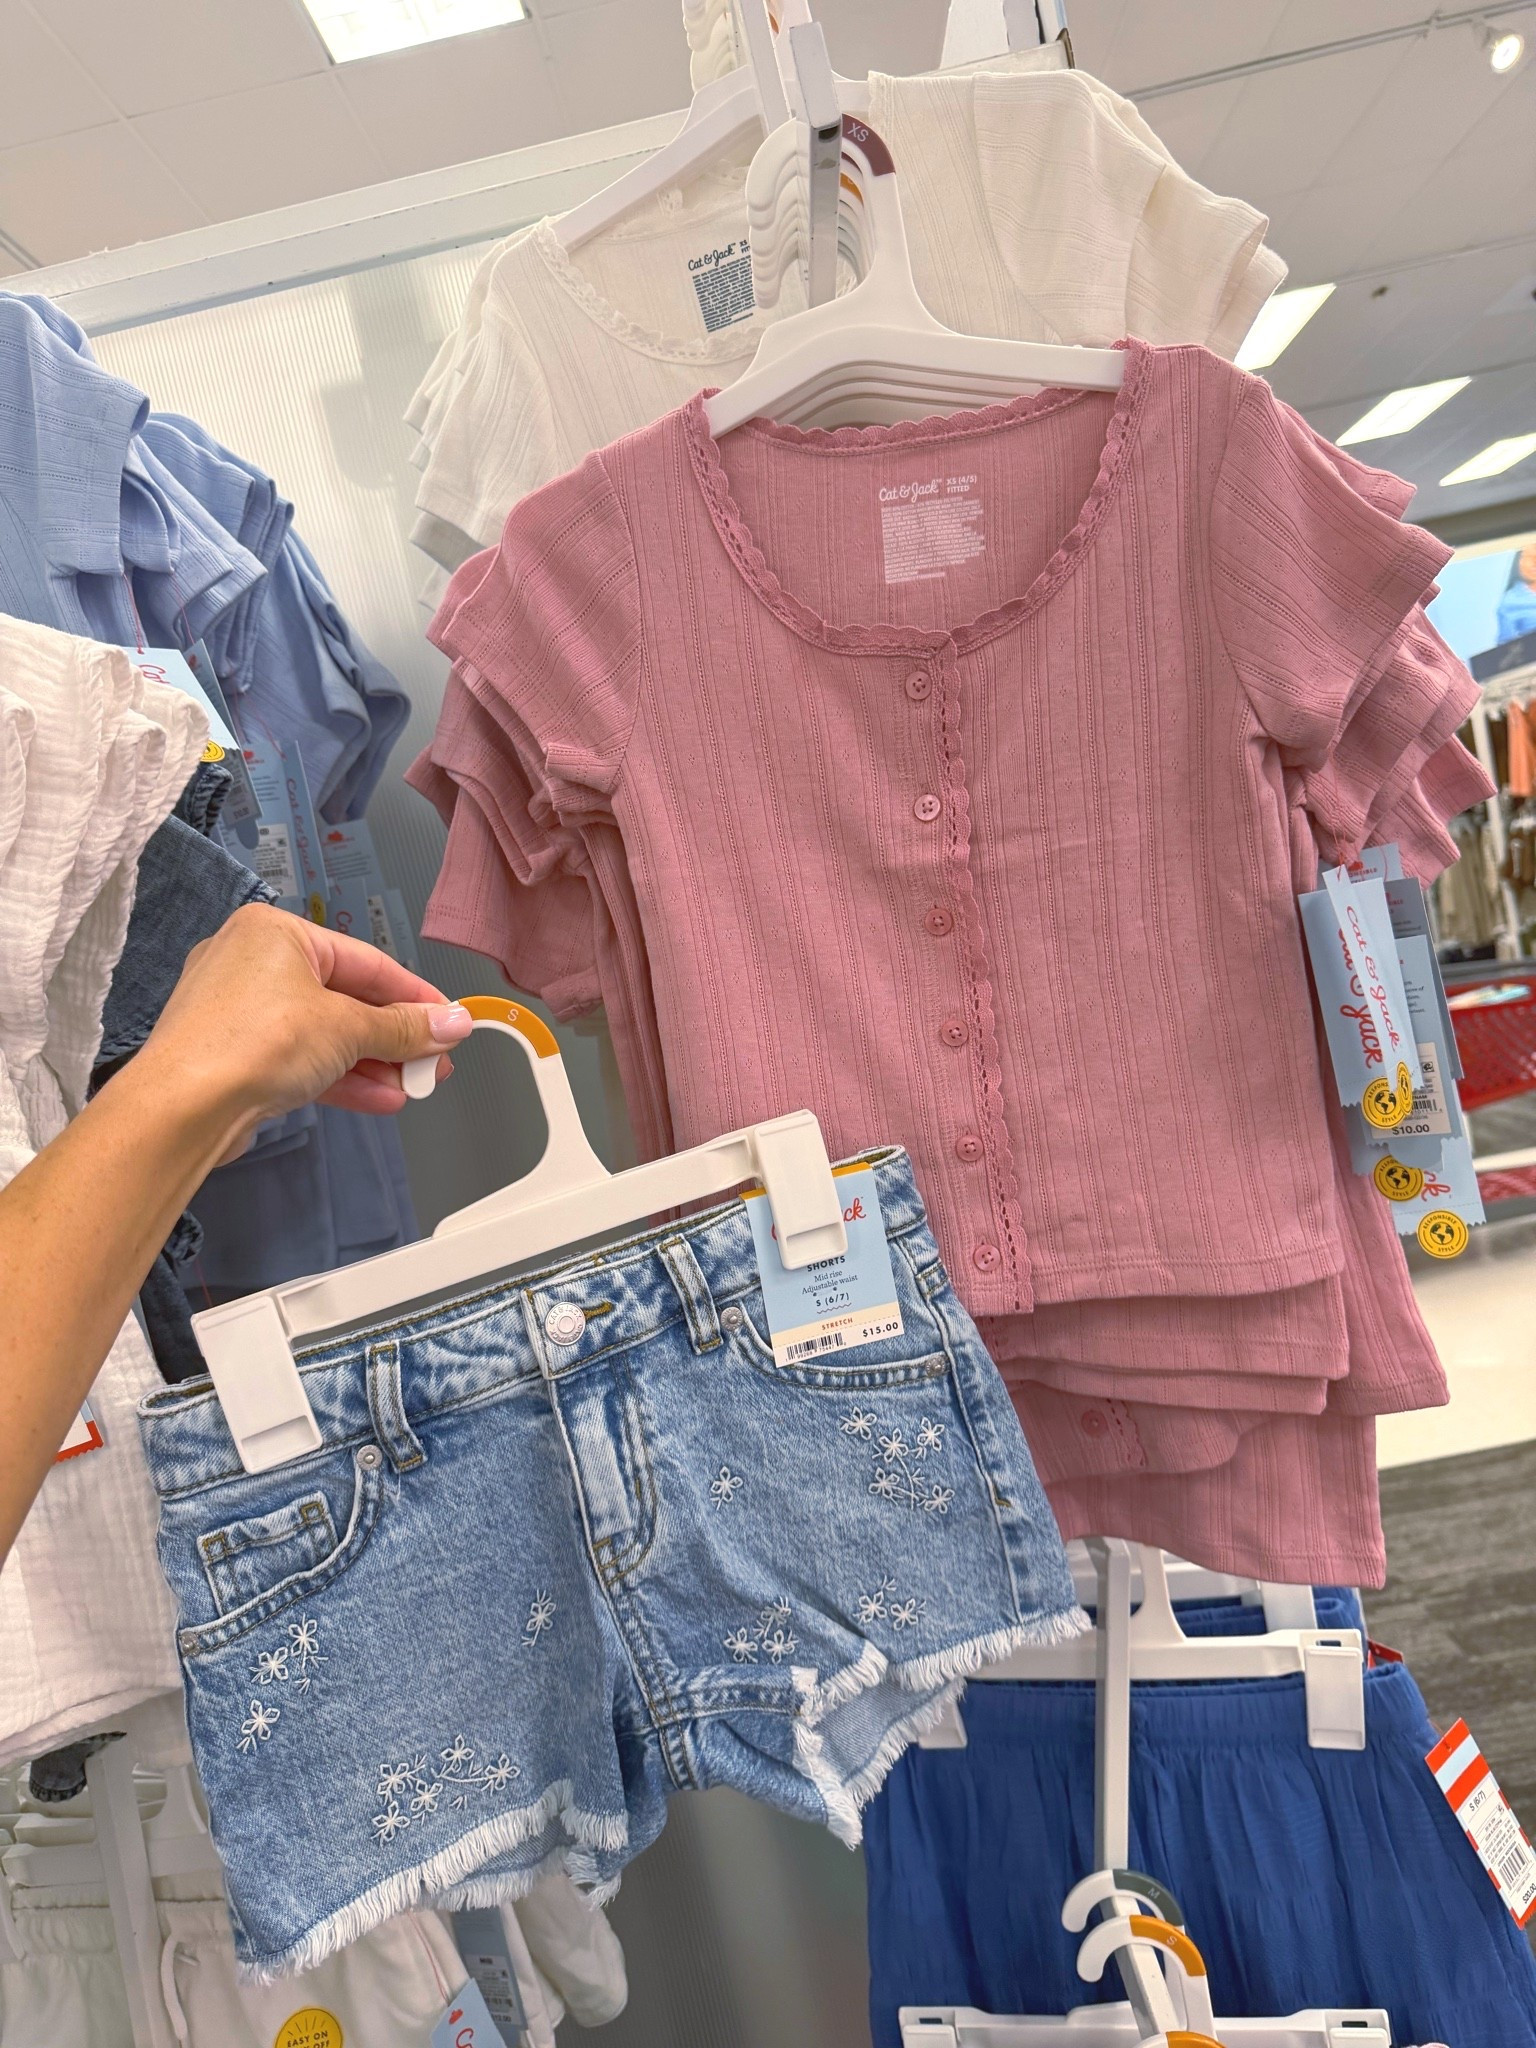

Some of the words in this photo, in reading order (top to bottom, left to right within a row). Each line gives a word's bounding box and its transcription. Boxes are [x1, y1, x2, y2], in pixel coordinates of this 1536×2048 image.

[847, 122, 869, 142] XS
[688, 258, 704, 271] Cat
[704, 254, 713, 264] &
[713, 245, 735, 267] Jack
[879, 487, 899, 501] Cat
[899, 485, 911, 498] &
[911, 479, 939, 503] Jack
[946, 477, 957, 485] XS
[947, 485, 970, 493] FITTED
[1347, 905, 1368, 953] Cat
[1369, 985, 1400, 1053] Jack
[507, 1008, 519, 1022] S
[1381, 1115, 1397, 1124] STYLE
[1392, 1124, 1430, 1136] $10.00
[1423, 1214, 1457, 1230] RESPONSIBLE
[1438, 1245, 1455, 1253] STYLE
[807, 1255, 846, 1273] SHORTS
[814, 1272, 829, 1283] Mid
[829, 1270, 843, 1279] rise
[802, 1279, 839, 1295] Adjustable
[838, 1274, 858, 1285] waist
[815, 1299, 822, 1307] S
[824, 1292, 850, 1306] (6/7)
[821, 1317, 853, 1331] STRETCH
[862, 1321, 899, 1338] $15.00
[1469, 1803, 1475, 1812] S
[1147, 1887, 1161, 1900] M
[1166, 1935, 1178, 1946] S
[288, 2035, 310, 2048] EASY
[313, 2030, 328, 2040] ON
